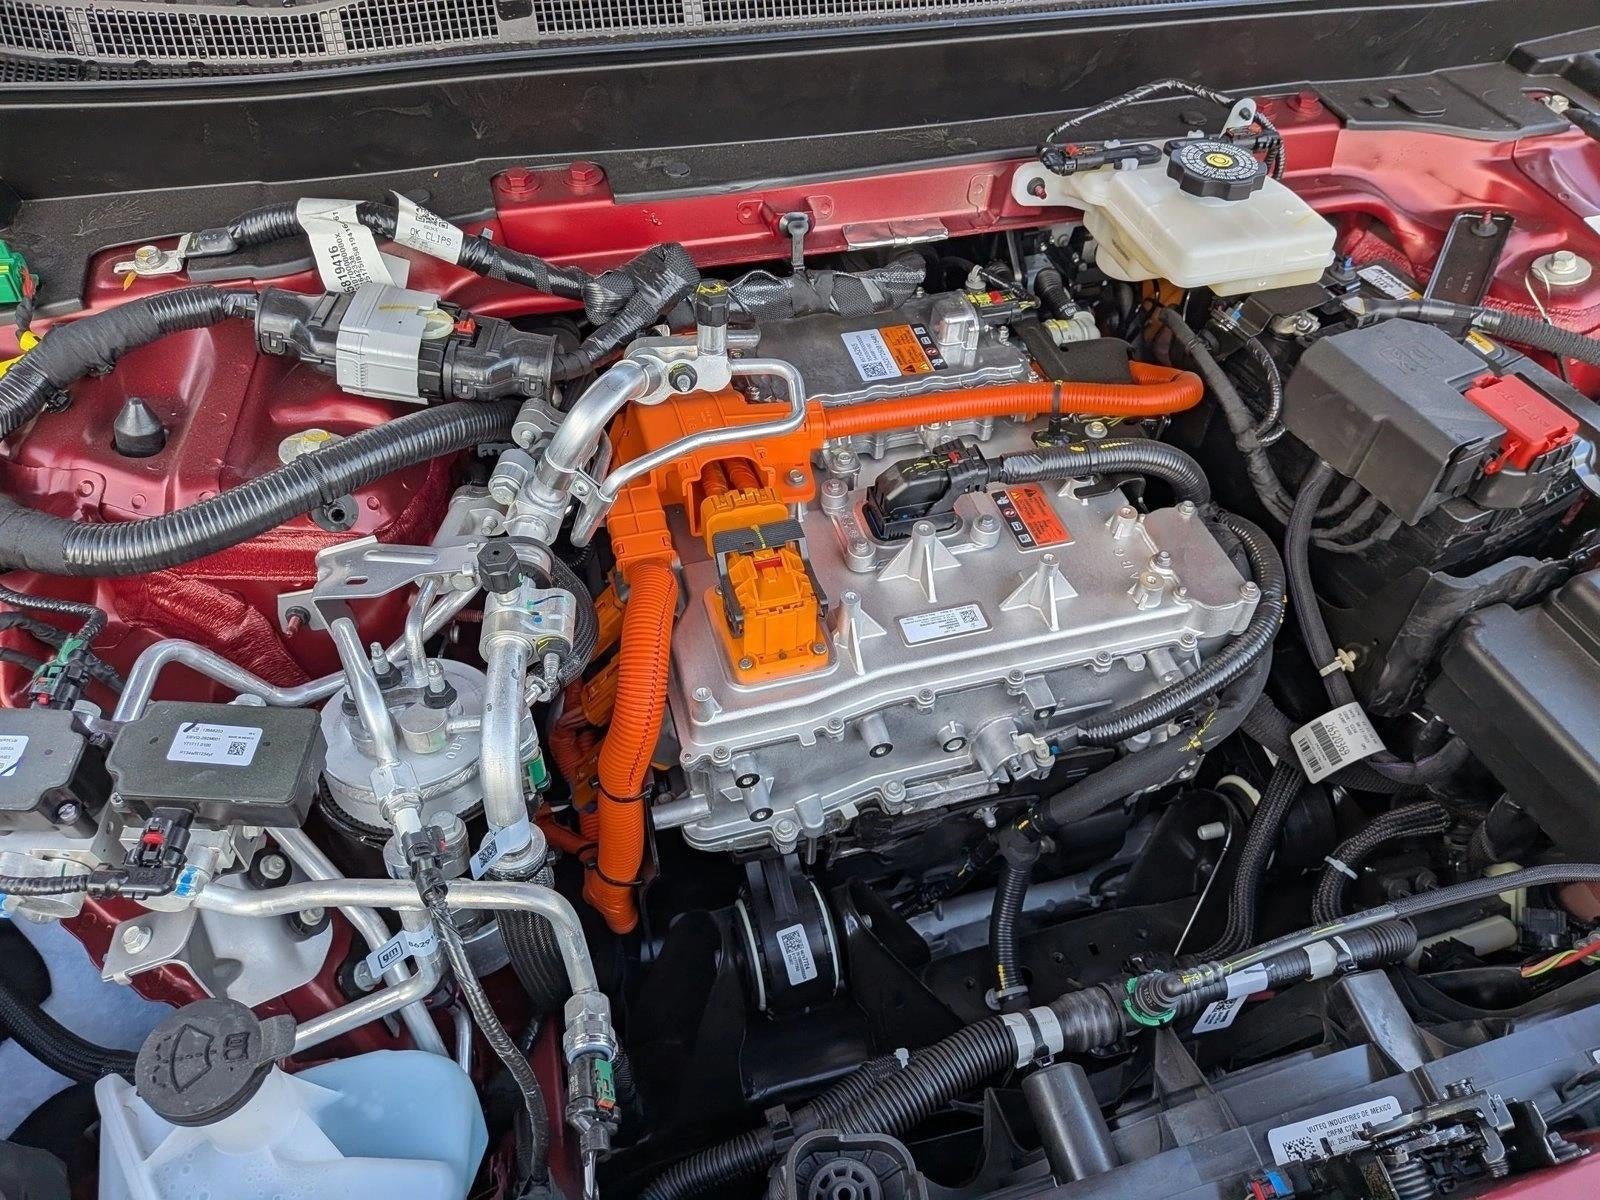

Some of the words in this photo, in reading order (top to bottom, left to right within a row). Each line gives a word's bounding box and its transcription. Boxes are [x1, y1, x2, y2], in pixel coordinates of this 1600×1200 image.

[409, 227, 421, 238] OK
[425, 231, 452, 246] CLIPS
[328, 246, 357, 295] 5819416
[1325, 722, 1350, 756] 26520369
[382, 947, 399, 964] gm
[1306, 1122, 1327, 1134] VUTEQ
[1328, 1113, 1361, 1128] INDUSTRIES
[1370, 1103, 1392, 1115] MEXICO
[1326, 1127, 1344, 1138] CRFM
[1344, 1123, 1359, 1134] C234
